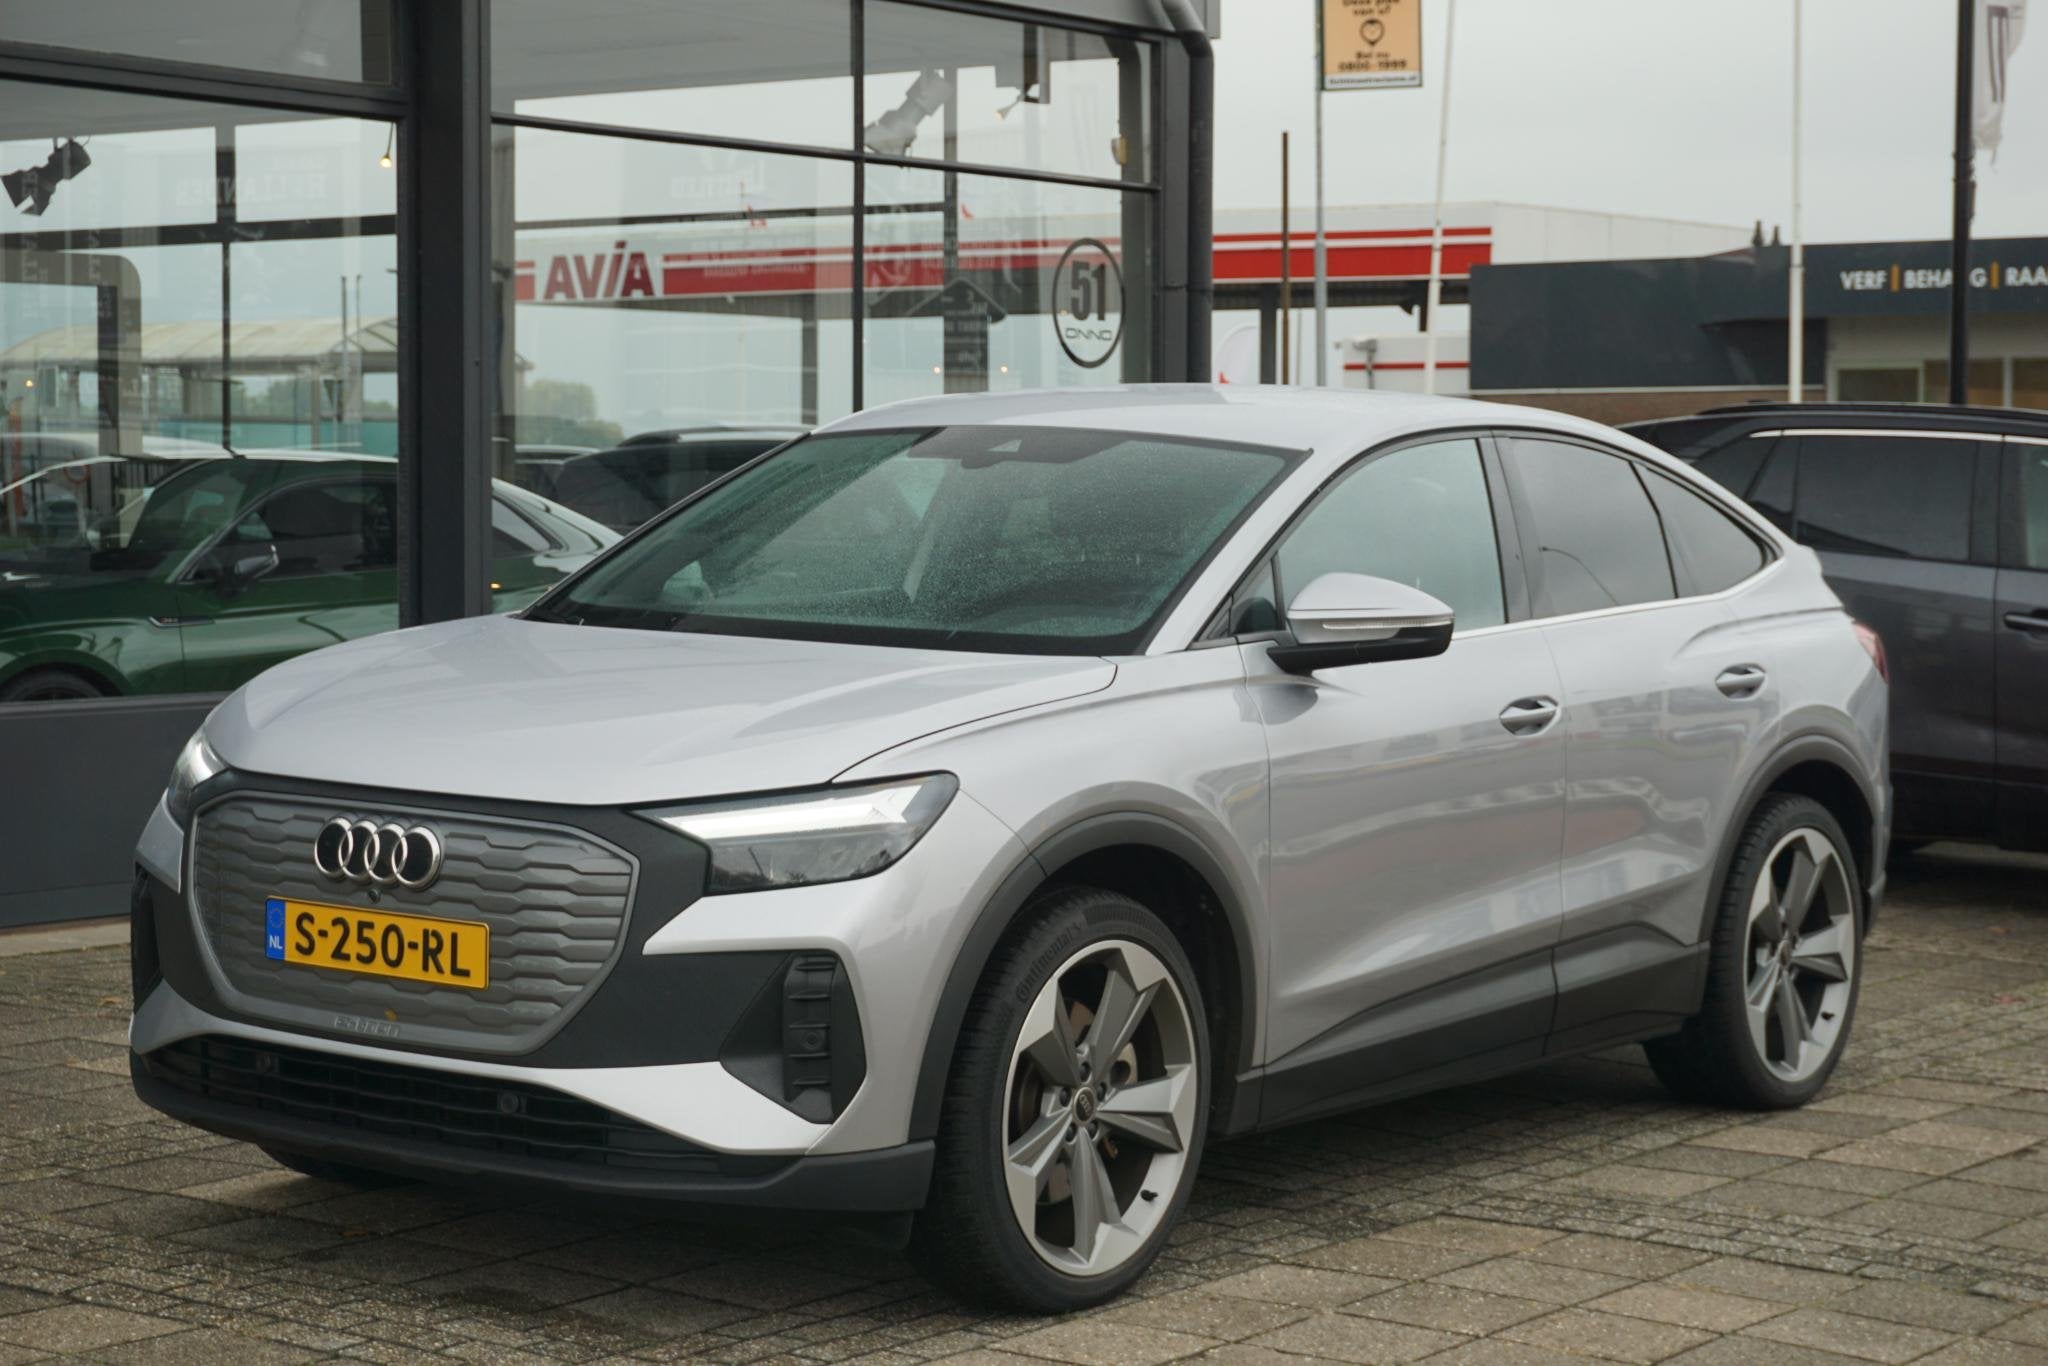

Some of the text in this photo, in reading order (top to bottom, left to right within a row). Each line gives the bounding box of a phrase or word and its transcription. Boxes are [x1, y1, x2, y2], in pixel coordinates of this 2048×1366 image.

[543, 240, 655, 301] AVIA
[1070, 260, 1106, 321] 51
[1840, 265, 2048, 290] VERF BEHAG RAA
[269, 935, 284, 950] NL
[294, 911, 471, 978] S-250-RL
